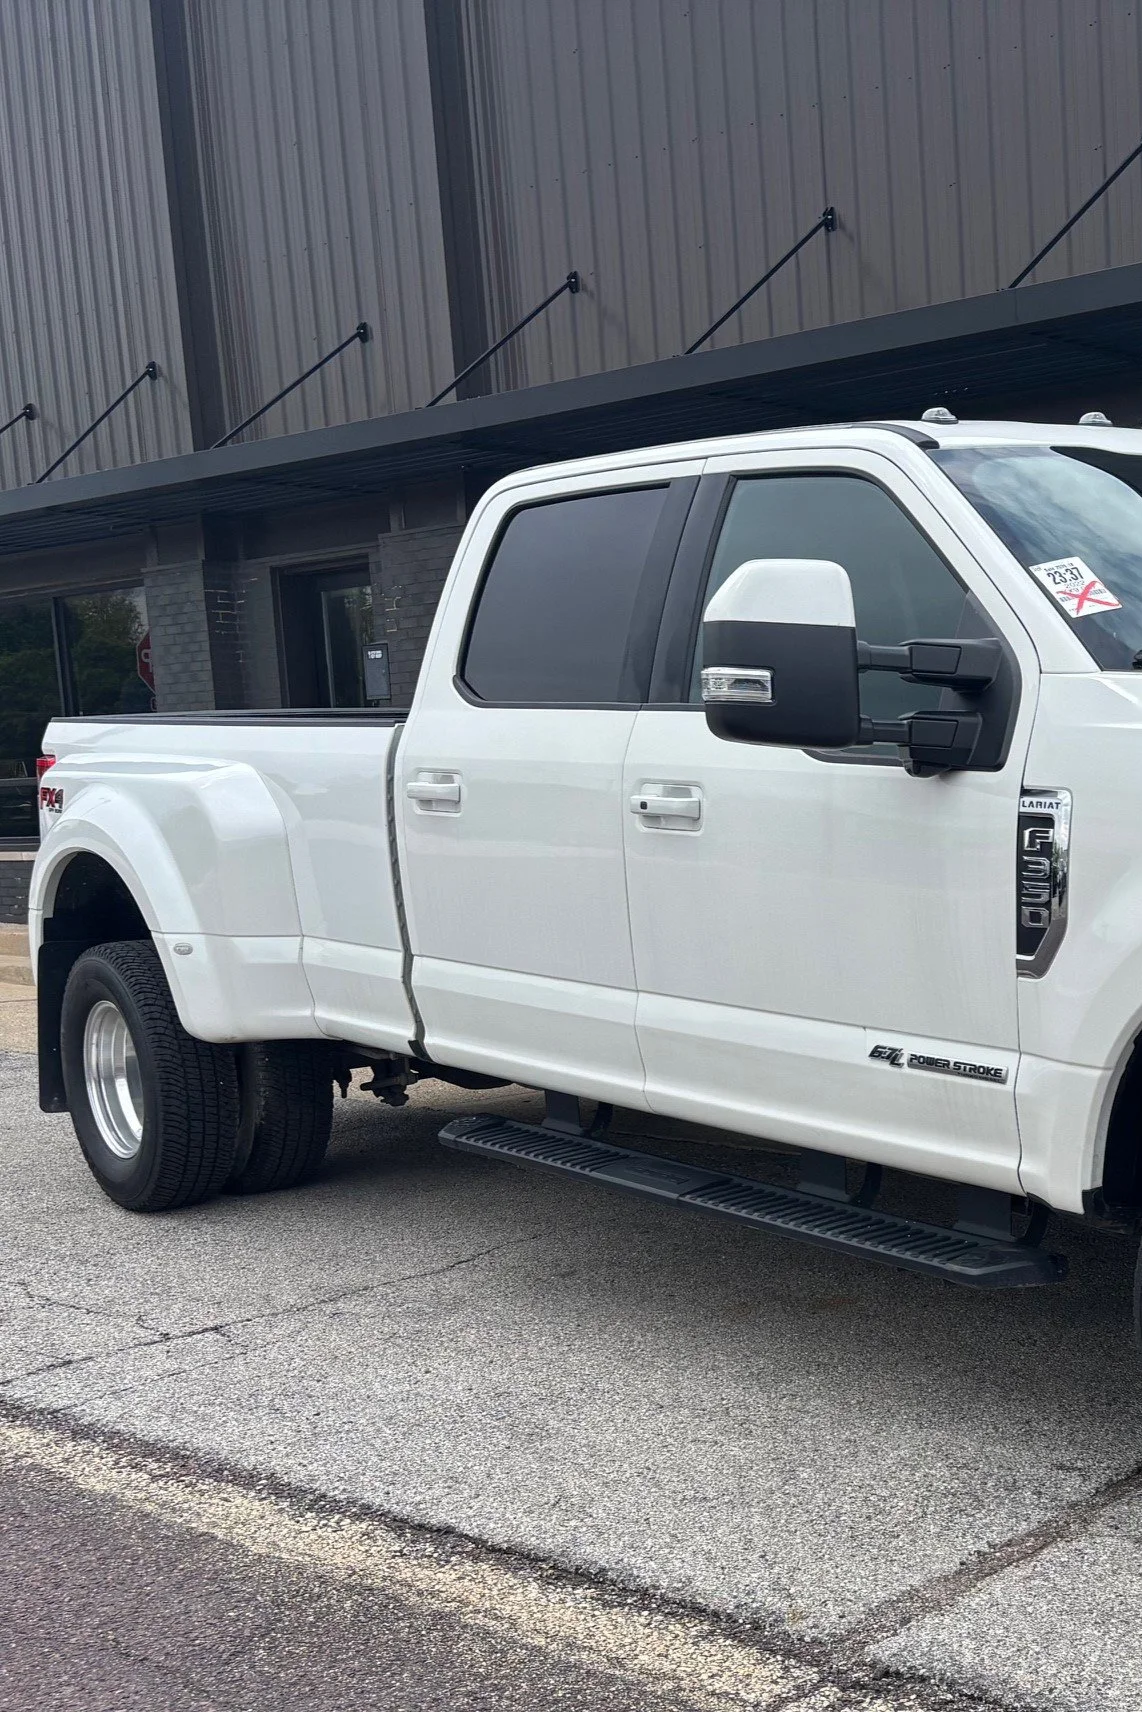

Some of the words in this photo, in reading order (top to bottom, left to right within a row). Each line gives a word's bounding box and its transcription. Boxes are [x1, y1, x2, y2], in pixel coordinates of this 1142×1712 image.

[1047, 567, 1084, 585] 23:37
[40, 787, 64, 810] FX4
[1022, 800, 1061, 810] LARIAT
[909, 1053, 951, 1069] POWER
[953, 1062, 1003, 1078] STROKE
